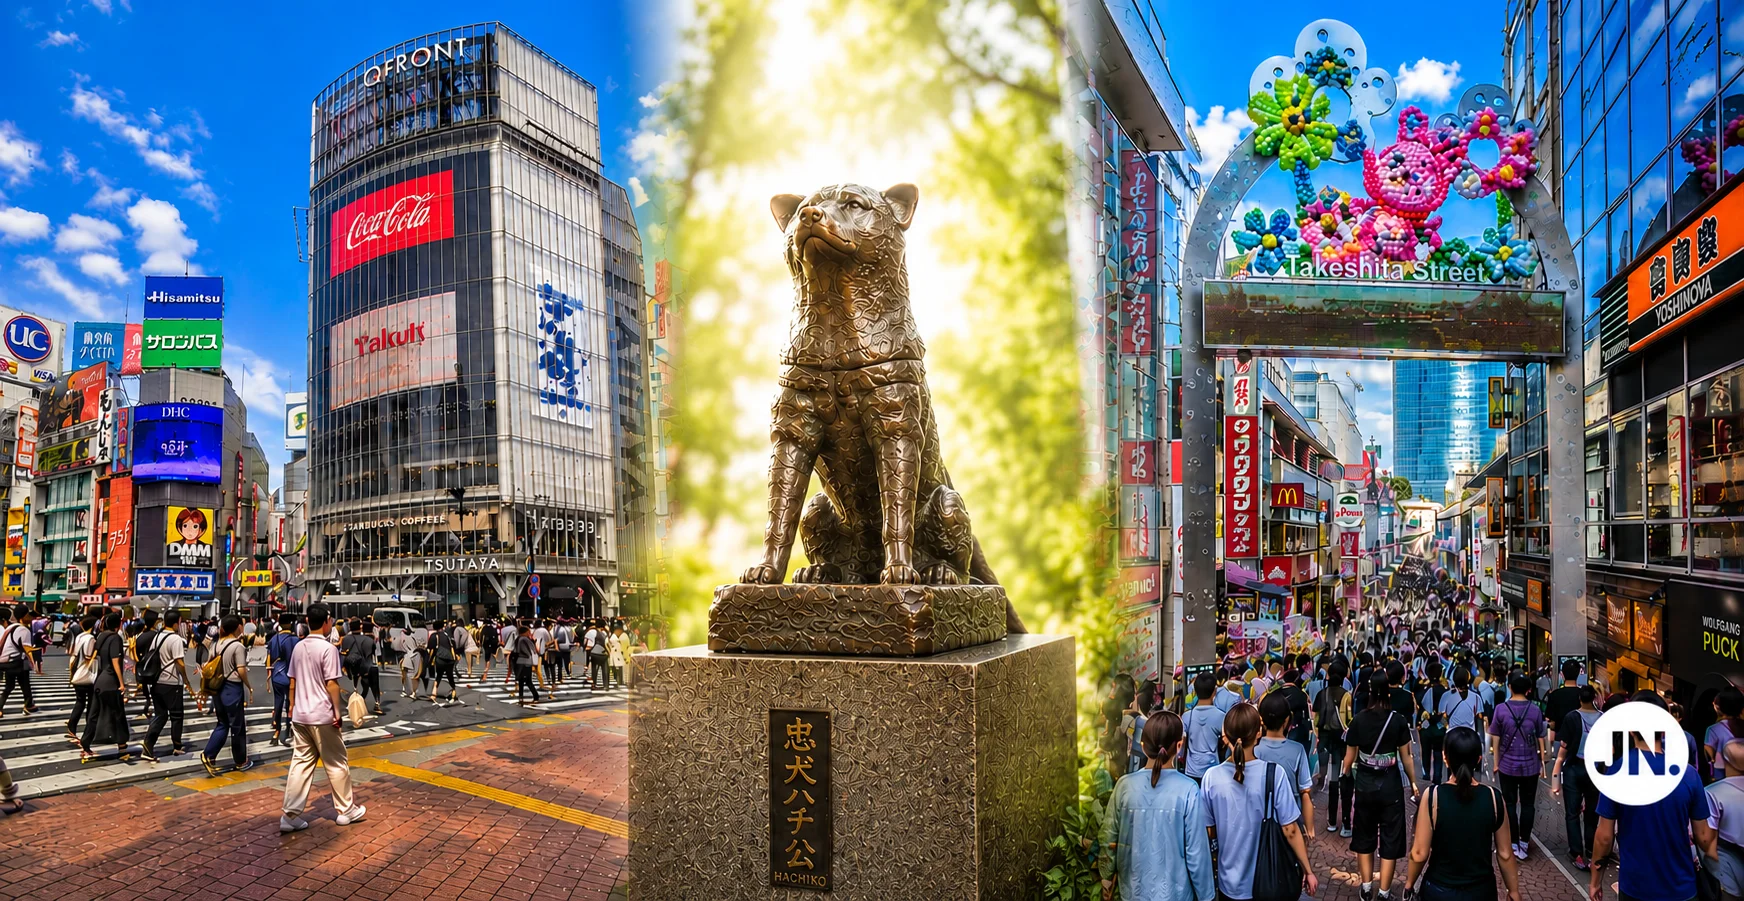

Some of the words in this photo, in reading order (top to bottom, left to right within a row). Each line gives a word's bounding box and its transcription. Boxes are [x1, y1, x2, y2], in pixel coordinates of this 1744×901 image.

[364, 38, 467, 87] QFRONT
[347, 192, 434, 250] Coca-Cola
[1285, 252, 1404, 281] Takeshita
[1413, 260, 1486, 283] Street
[147, 290, 221, 303] Hisamitsu
[10, 323, 47, 351] UC
[33, 369, 55, 383] VISA
[162, 406, 190, 418] DHC
[169, 542, 211, 557] DMM
[424, 557, 500, 572] TSUTAYA
[1702, 615, 1741, 637] WOLFGANG
[1703, 631, 1740, 662] PUCK
[783, 716, 817, 870] 忠犬ハチ公
[774, 871, 827, 888] HACHIKO
